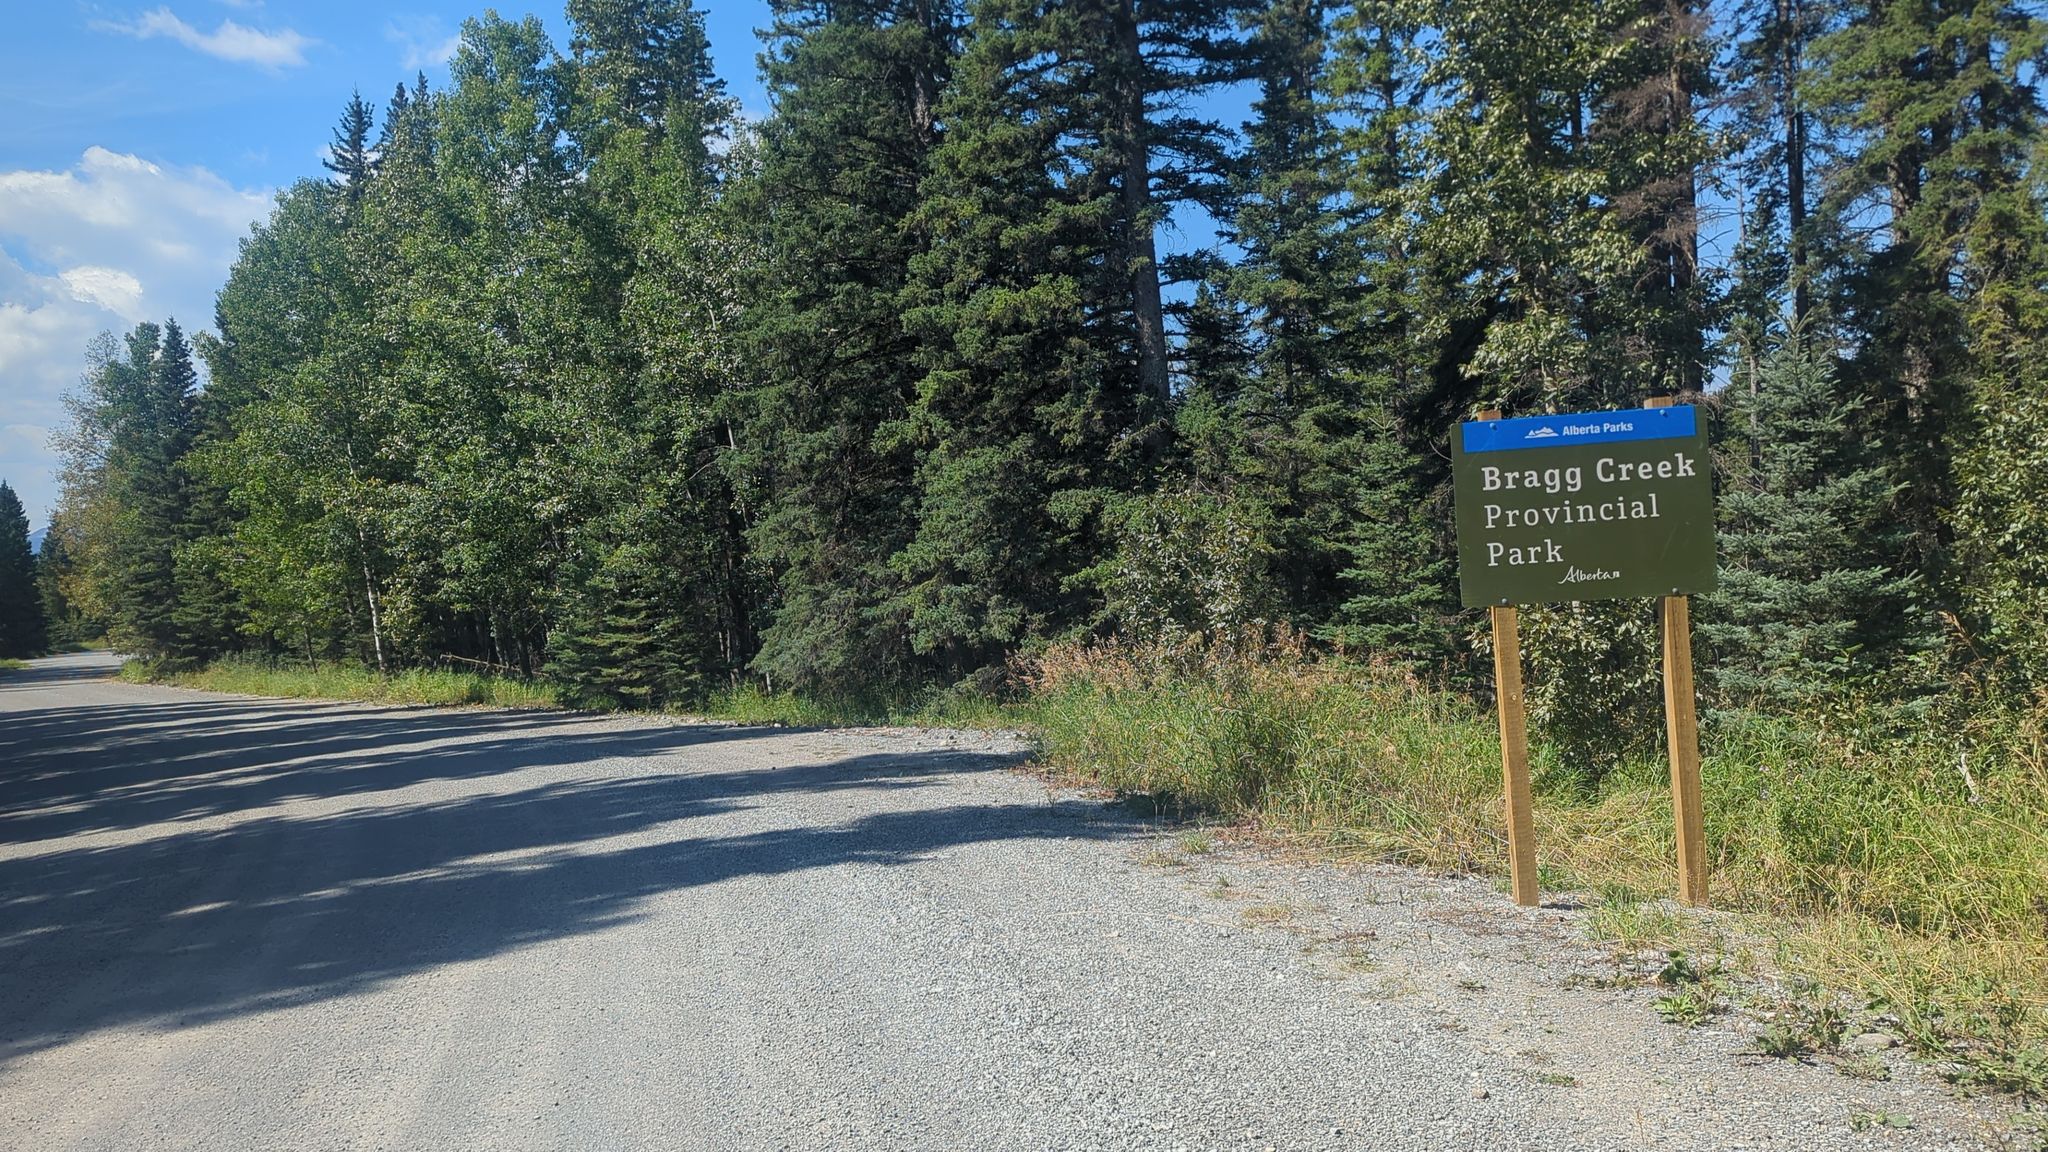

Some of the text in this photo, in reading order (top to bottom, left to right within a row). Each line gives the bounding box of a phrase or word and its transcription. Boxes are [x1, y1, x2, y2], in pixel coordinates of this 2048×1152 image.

[1562, 422, 1634, 437] Alberta Parks
[1481, 453, 1696, 493] Bragg Creek
[1484, 493, 1660, 529] Provincial
[1486, 539, 1564, 567] Park
[1558, 565, 1614, 584] Alberta
